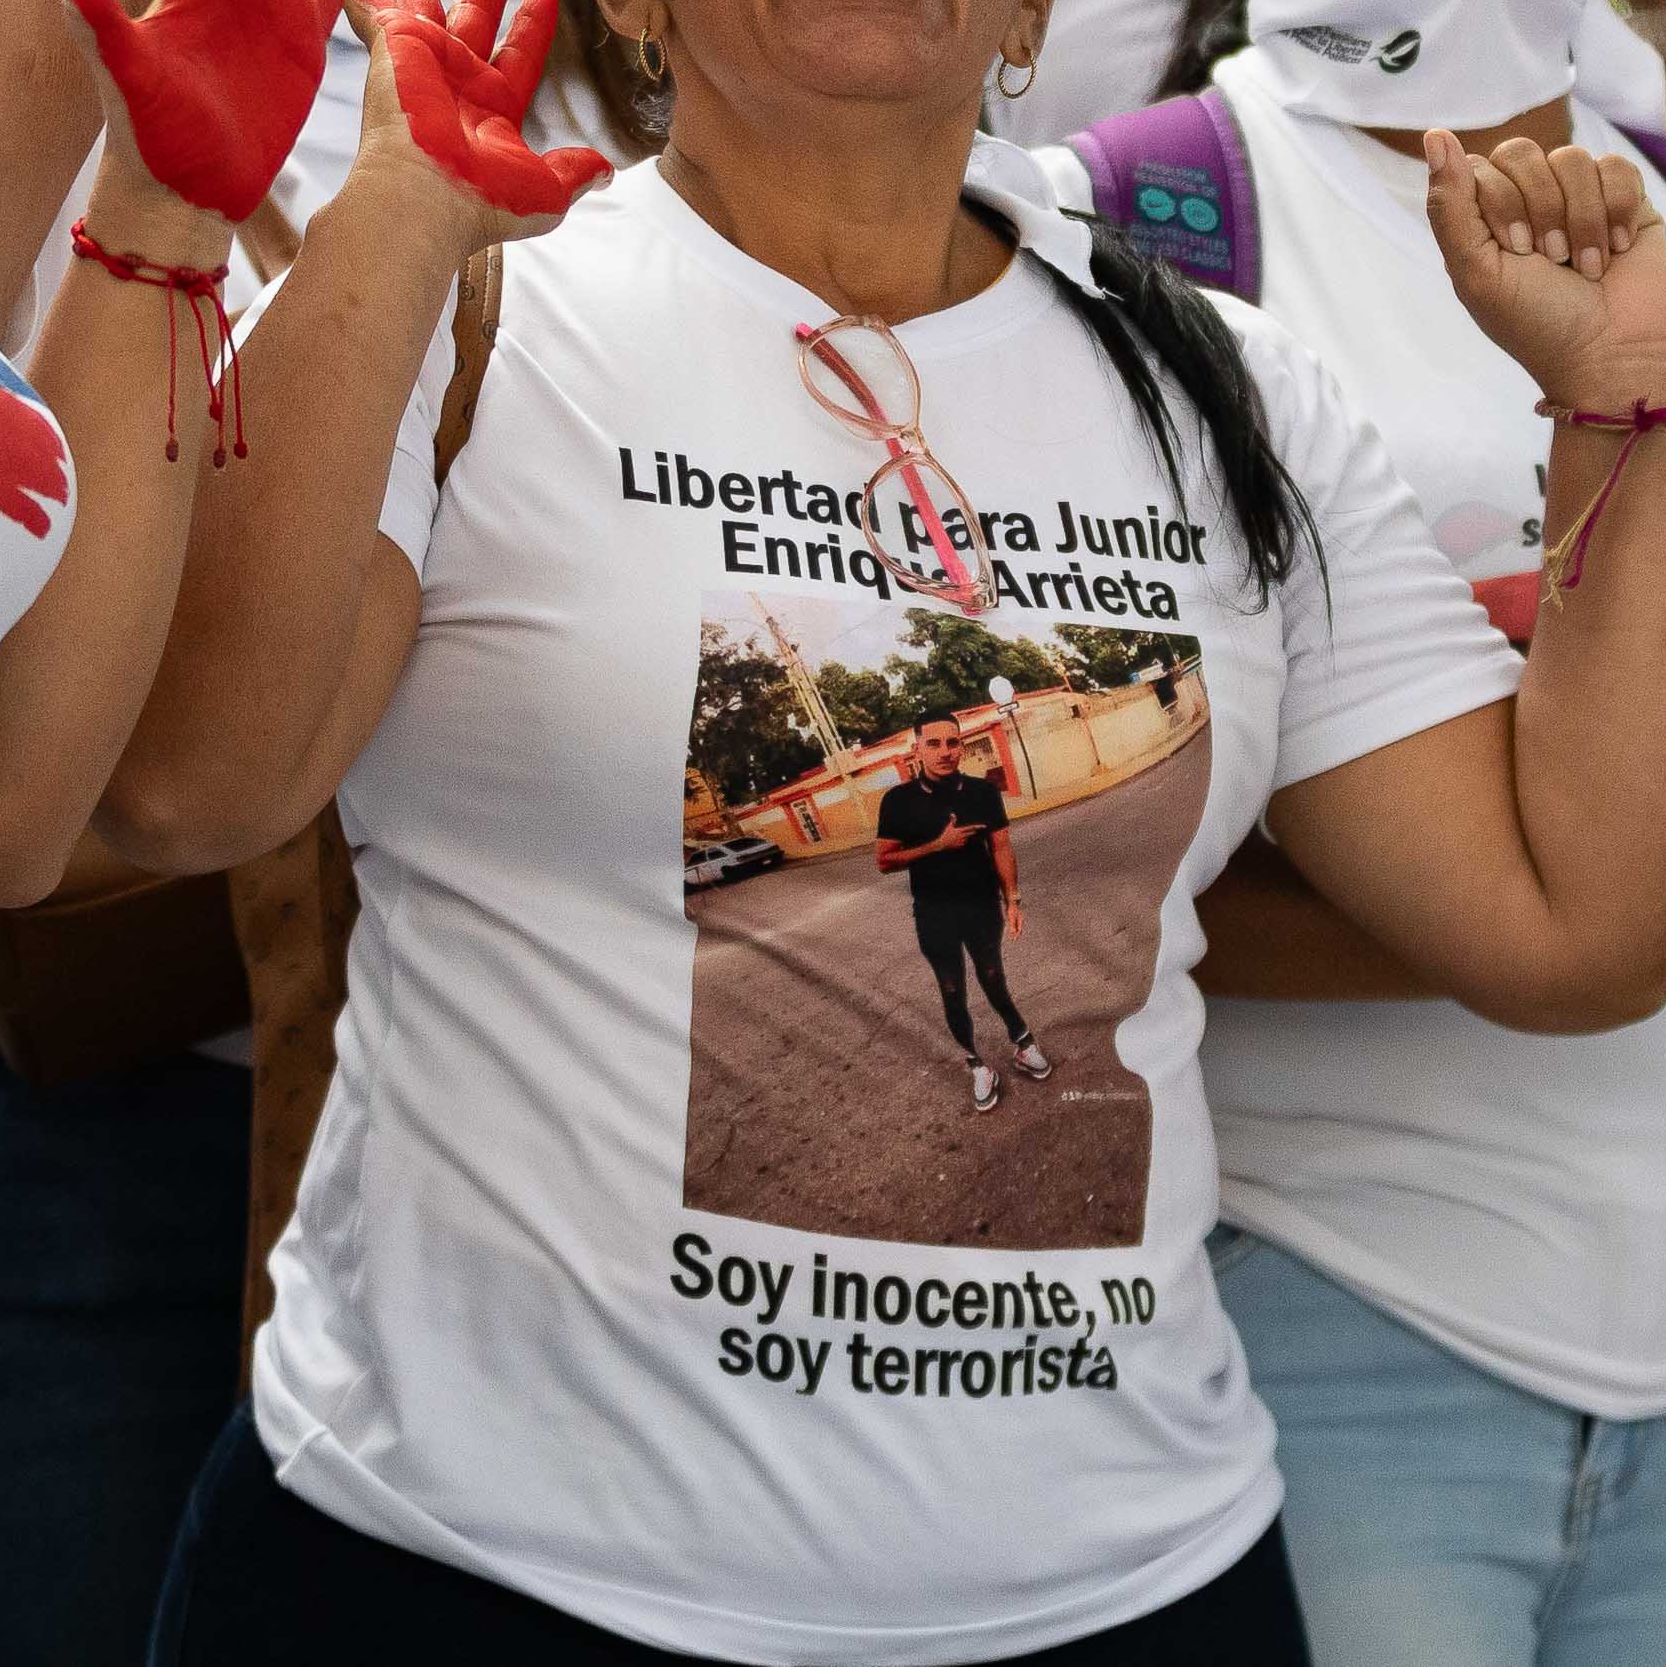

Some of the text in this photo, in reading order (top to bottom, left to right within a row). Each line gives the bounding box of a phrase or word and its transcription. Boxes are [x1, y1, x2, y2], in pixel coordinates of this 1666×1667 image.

[619, 446, 1208, 567] Libertad para Junior
[991, 560, 1181, 622] Arrieta
[669, 1232, 1157, 1337] Soy inocente, no
[718, 1327, 1120, 1399] soy terrorista
